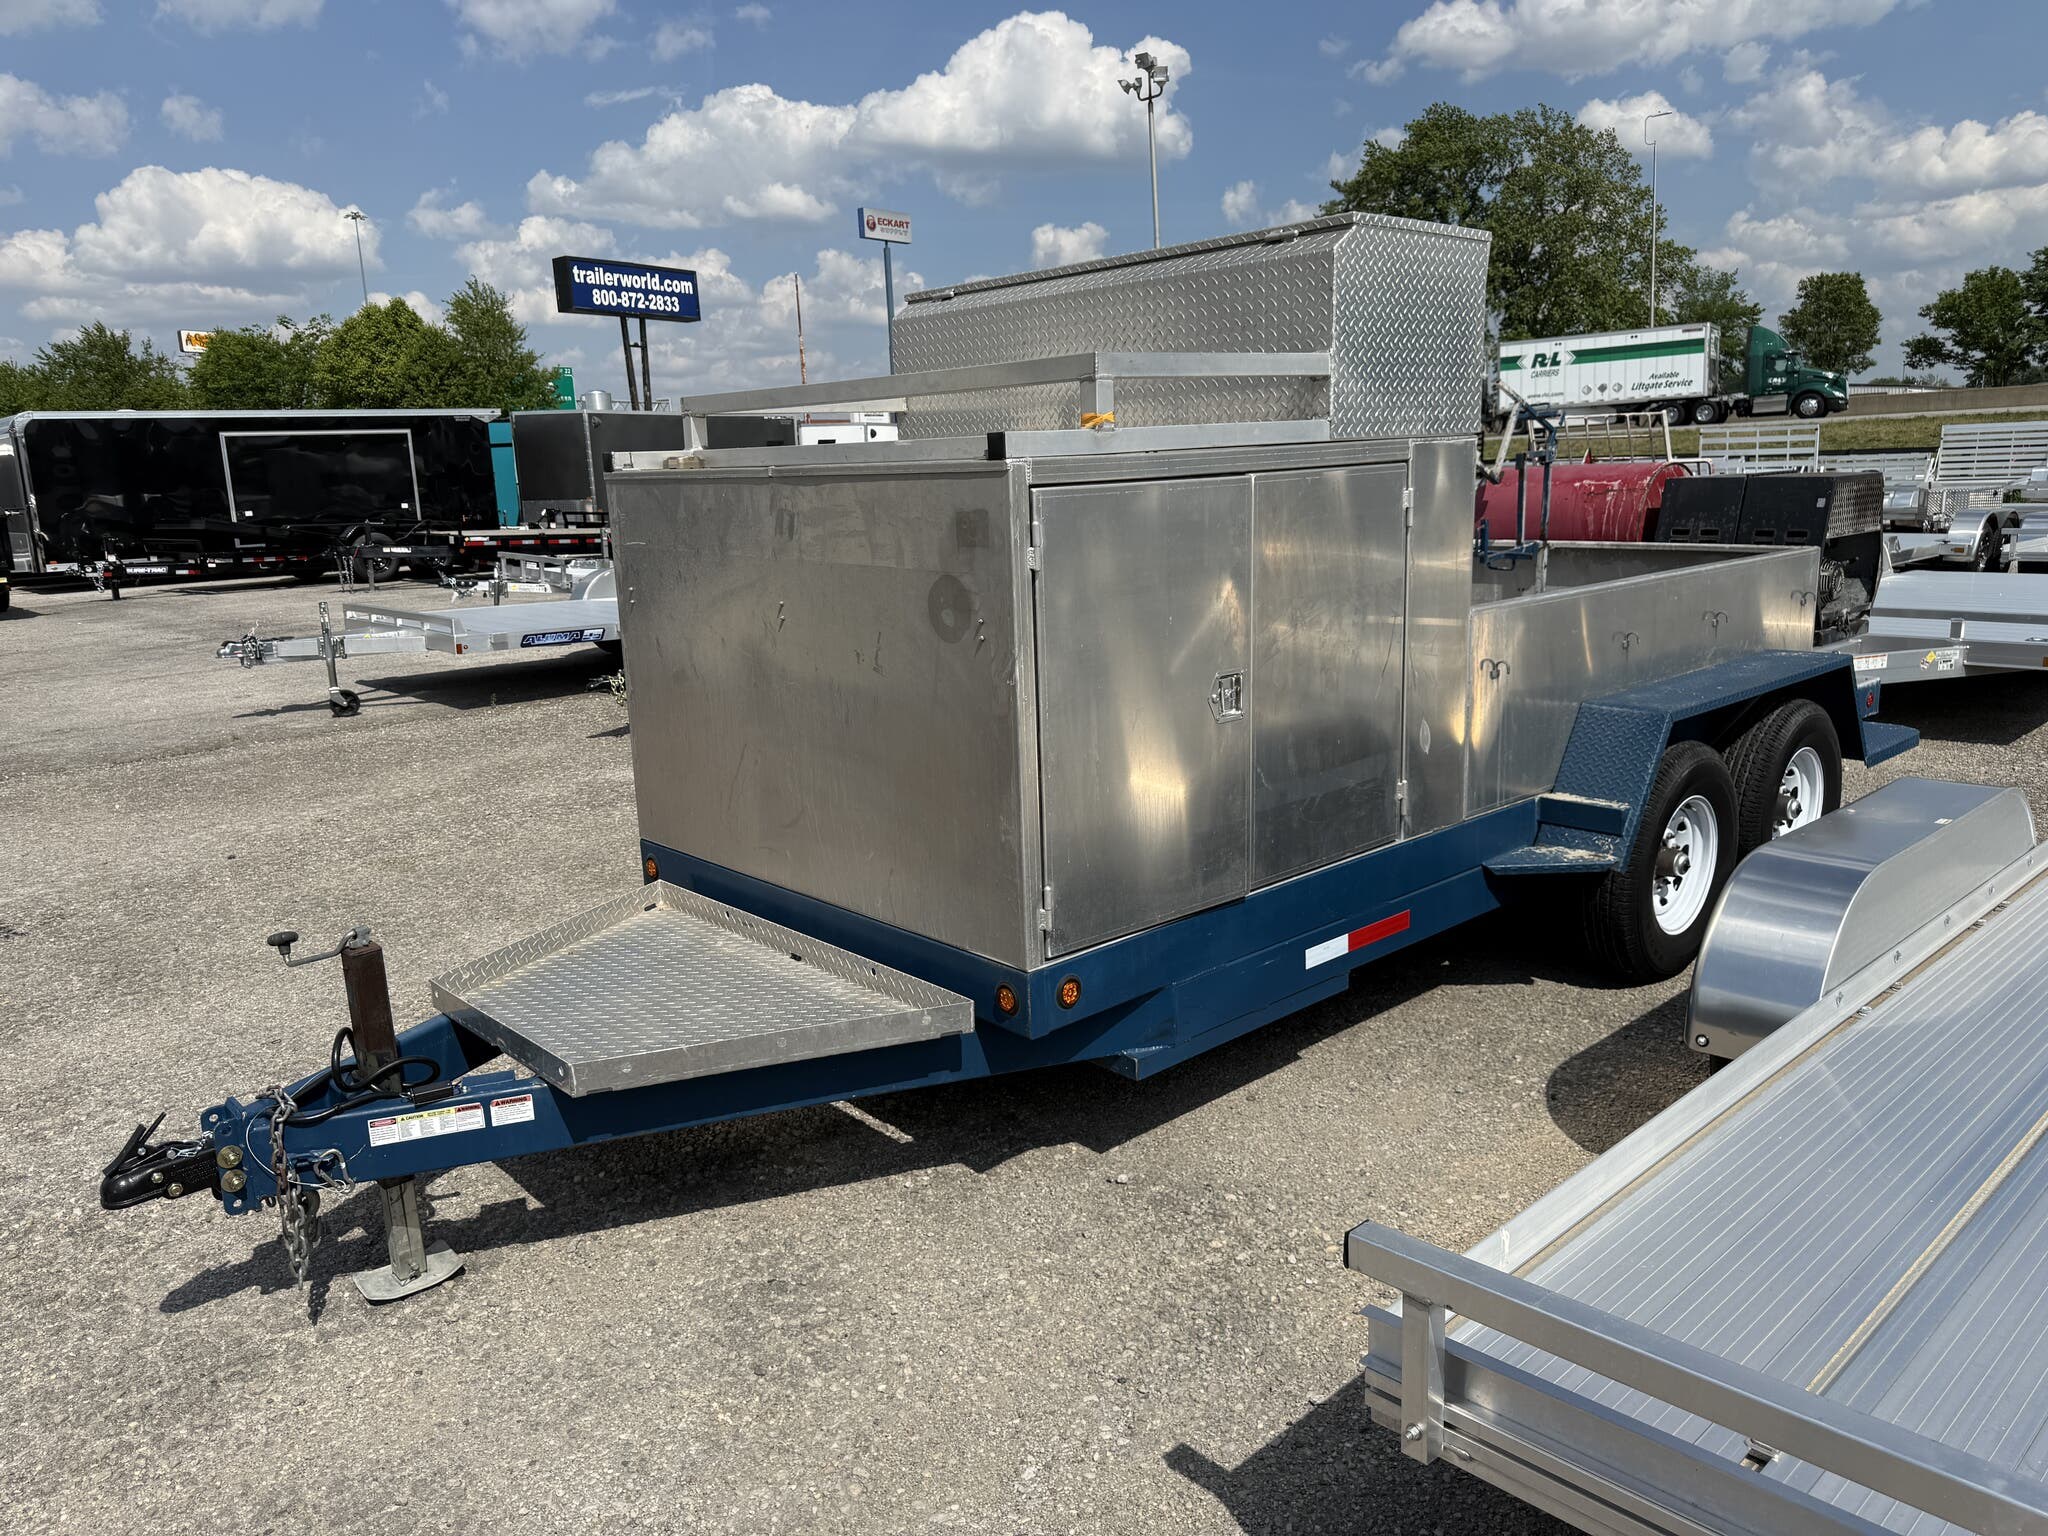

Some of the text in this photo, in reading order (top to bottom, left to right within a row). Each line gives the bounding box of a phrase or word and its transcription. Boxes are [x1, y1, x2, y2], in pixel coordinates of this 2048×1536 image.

[877, 217, 910, 229] ECKART
[572, 265, 694, 294] trailerworld.com
[592, 288, 680, 312] 800-872-2833
[1530, 369, 1560, 379] CARRIERS
[1649, 371, 1680, 380] Available
[1631, 378, 1694, 392] Liftgate Service
[522, 631, 581, 645] ALUMA
[500, 1096, 528, 1106] WARNING
